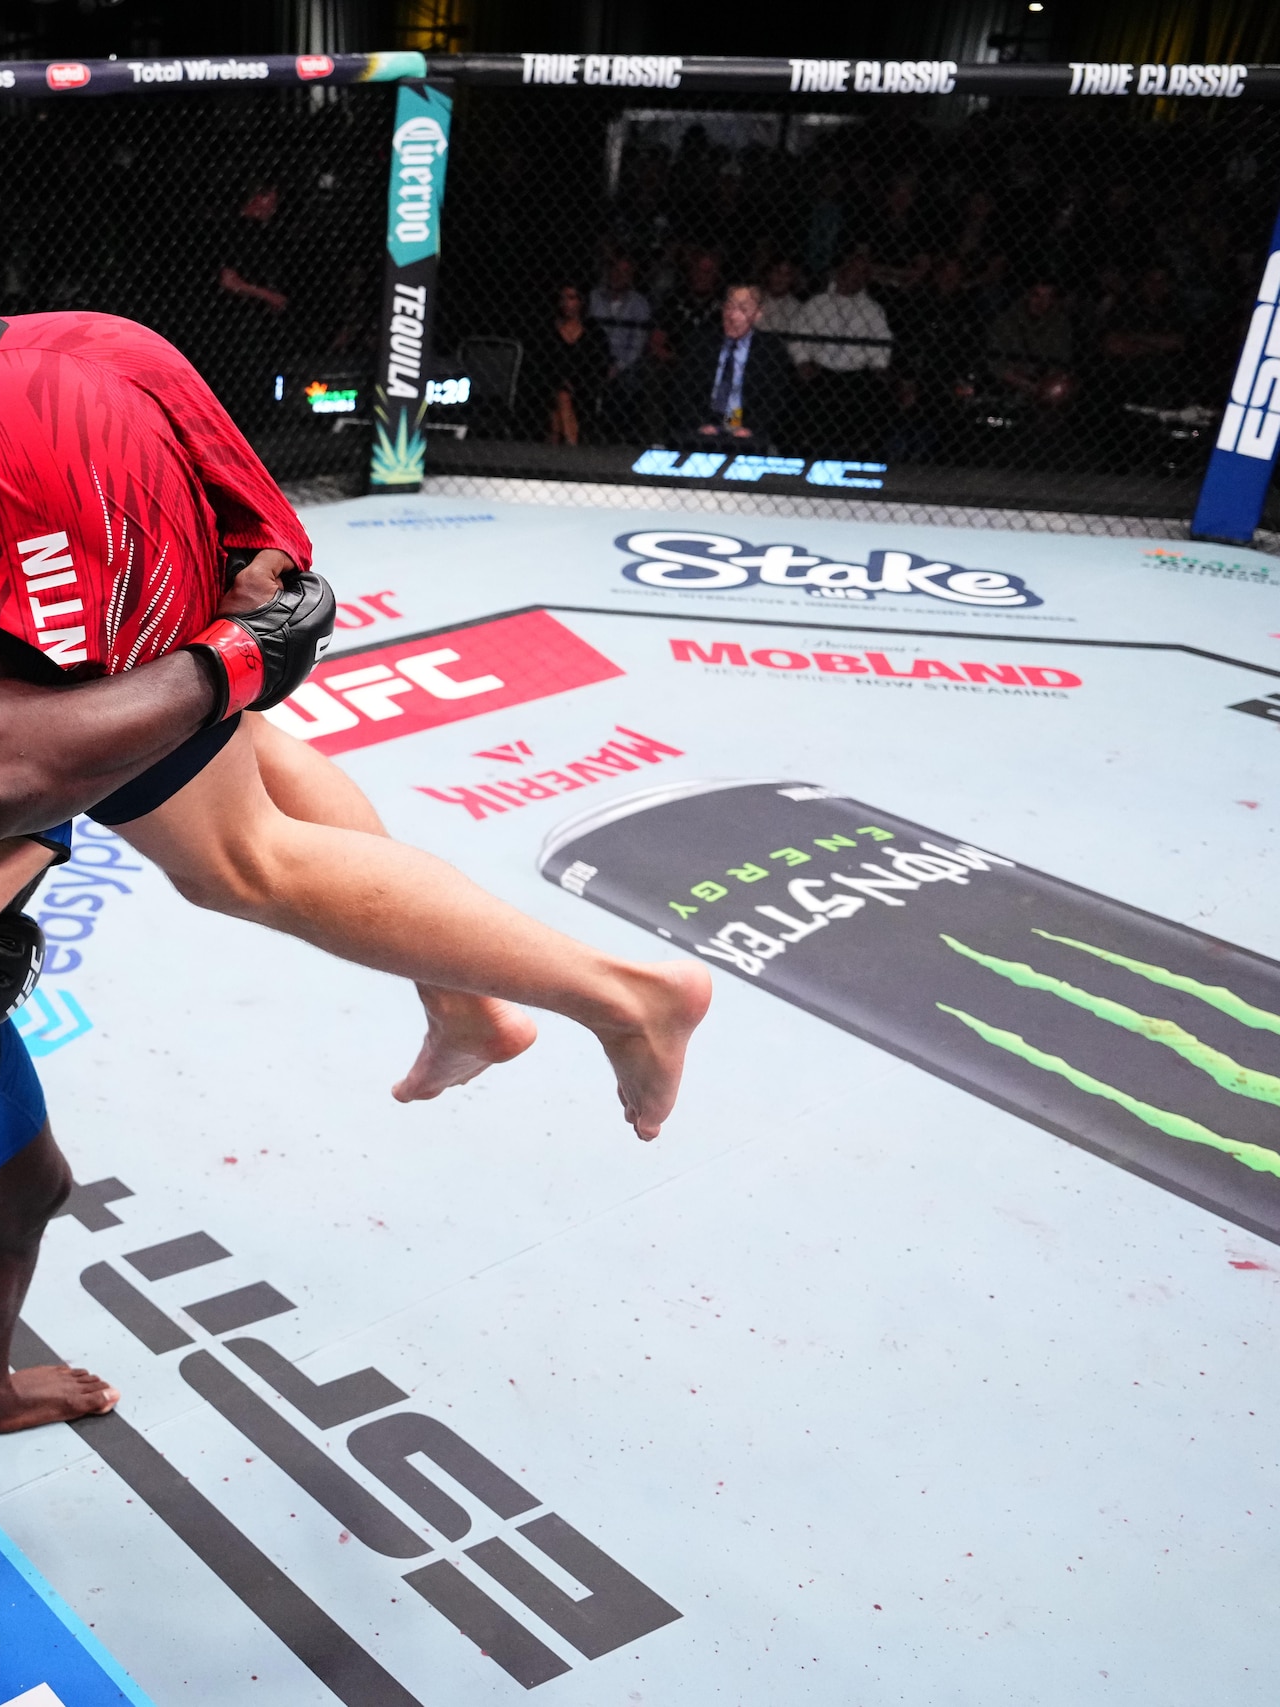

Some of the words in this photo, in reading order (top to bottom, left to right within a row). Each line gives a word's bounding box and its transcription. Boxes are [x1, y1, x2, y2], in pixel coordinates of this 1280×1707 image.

[128, 62, 182, 83] Total
[184, 59, 269, 81] Wireless
[521, 53, 580, 84] TRUE
[582, 55, 683, 89] CLASSIC
[789, 59, 851, 92] TRUE
[854, 61, 959, 94] CLASSIC
[1069, 63, 1134, 95] TRUE
[1137, 64, 1249, 97] CLASSIC
[392, 117, 448, 243] Cuervo
[386, 283, 426, 399] TEQUILA
[631, 449, 888, 489] UFC
[615, 531, 1043, 608] Stake
[261, 647, 505, 740] UFC
[668, 638, 1083, 689] MOBLAND
[855, 677, 913, 688] NOW
[923, 681, 1070, 700] STREAMING
[410, 724, 686, 821] MAVERIK
[668, 825, 895, 920] ENERGY
[694, 842, 1017, 977] MONSTER
